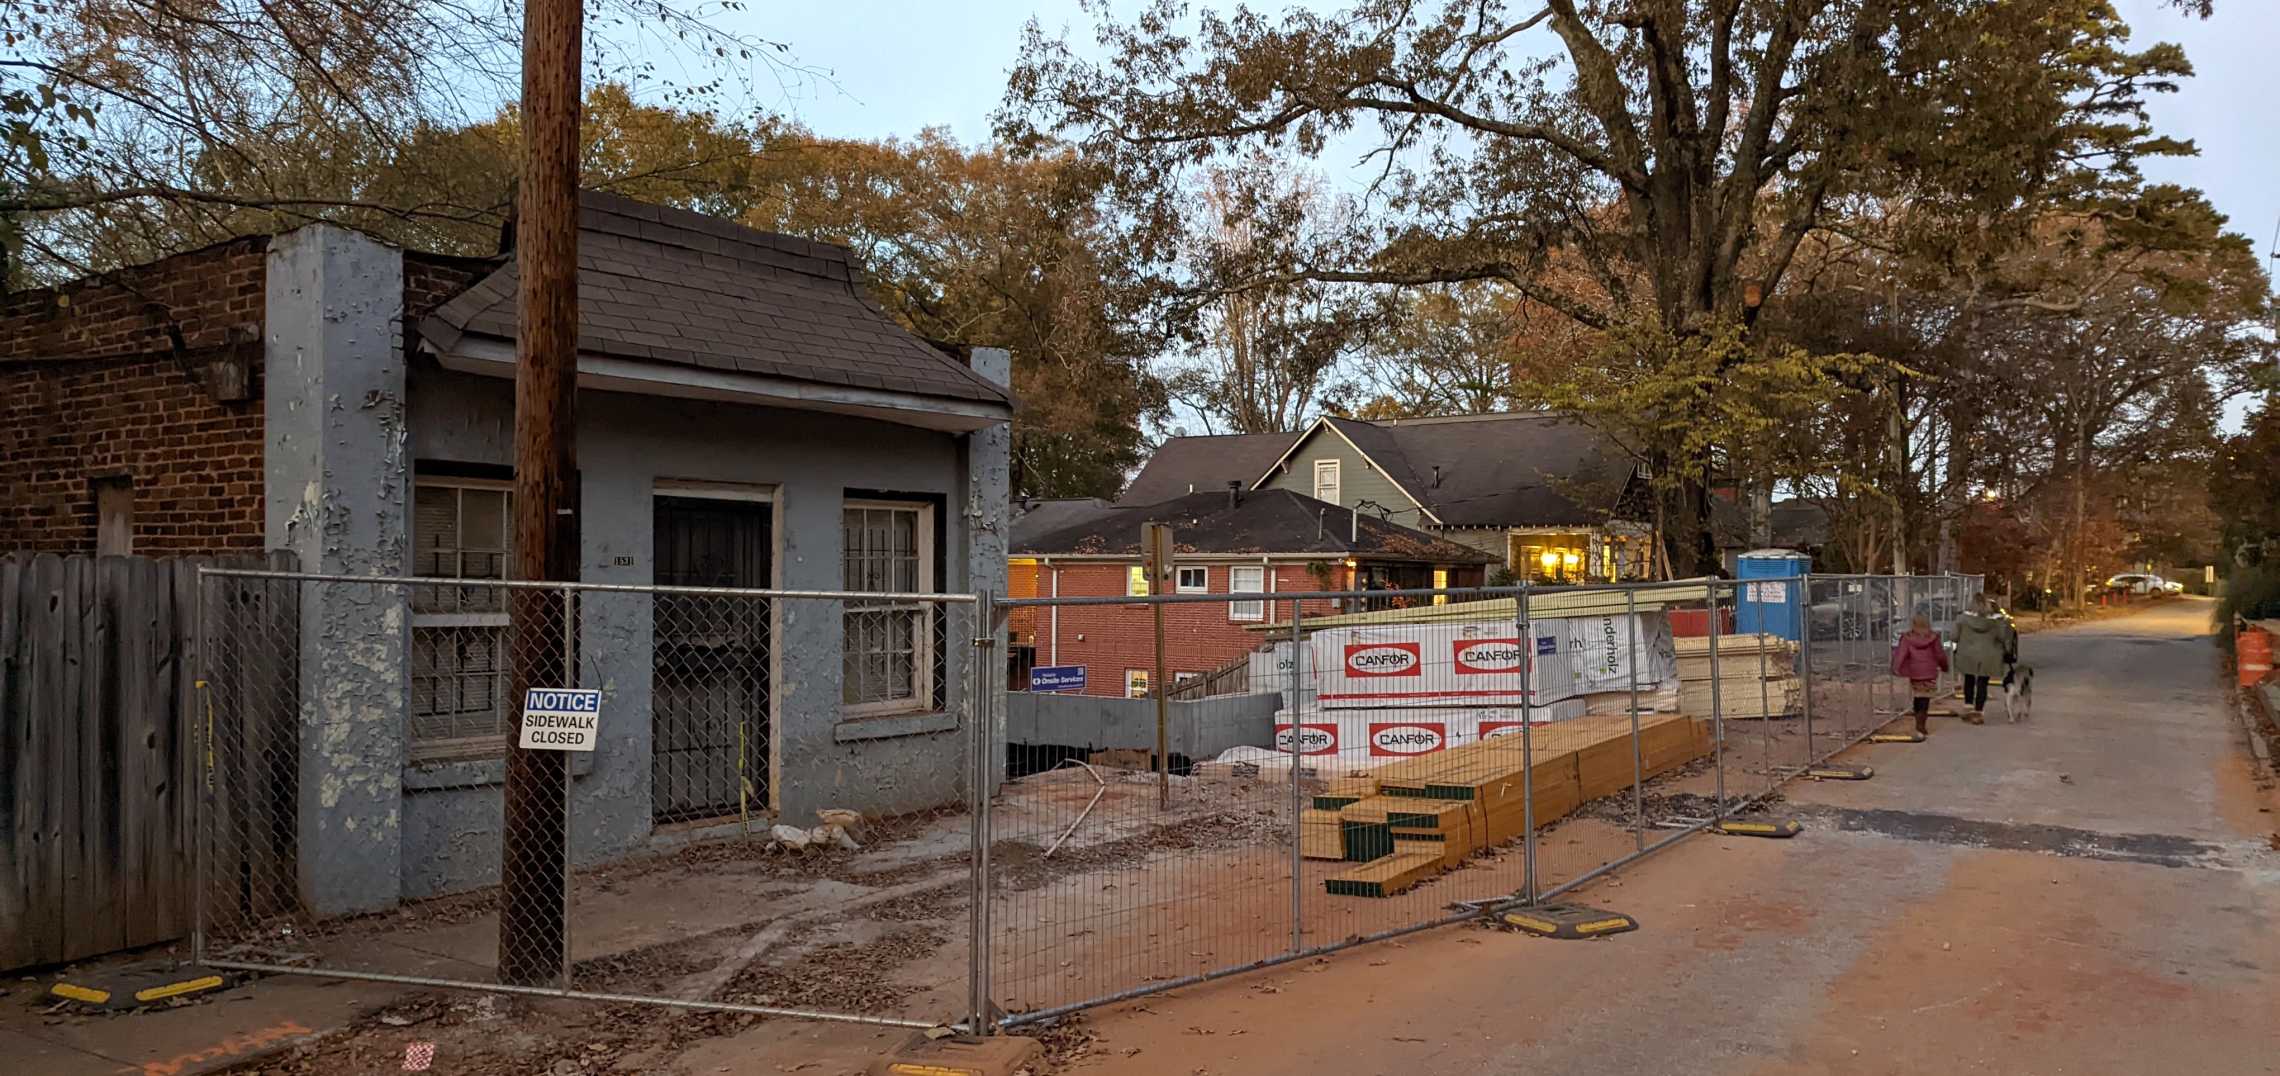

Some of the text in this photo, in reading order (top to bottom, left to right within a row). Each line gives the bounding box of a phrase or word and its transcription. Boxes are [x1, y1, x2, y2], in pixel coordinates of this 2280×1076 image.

[1355, 652, 1409, 668] CANFOR
[529, 692, 596, 711] NOTICE
[525, 714, 594, 729] SIDEWALK
[531, 730, 585, 745] CLOSED
[1380, 730, 1434, 745] CANFOR
